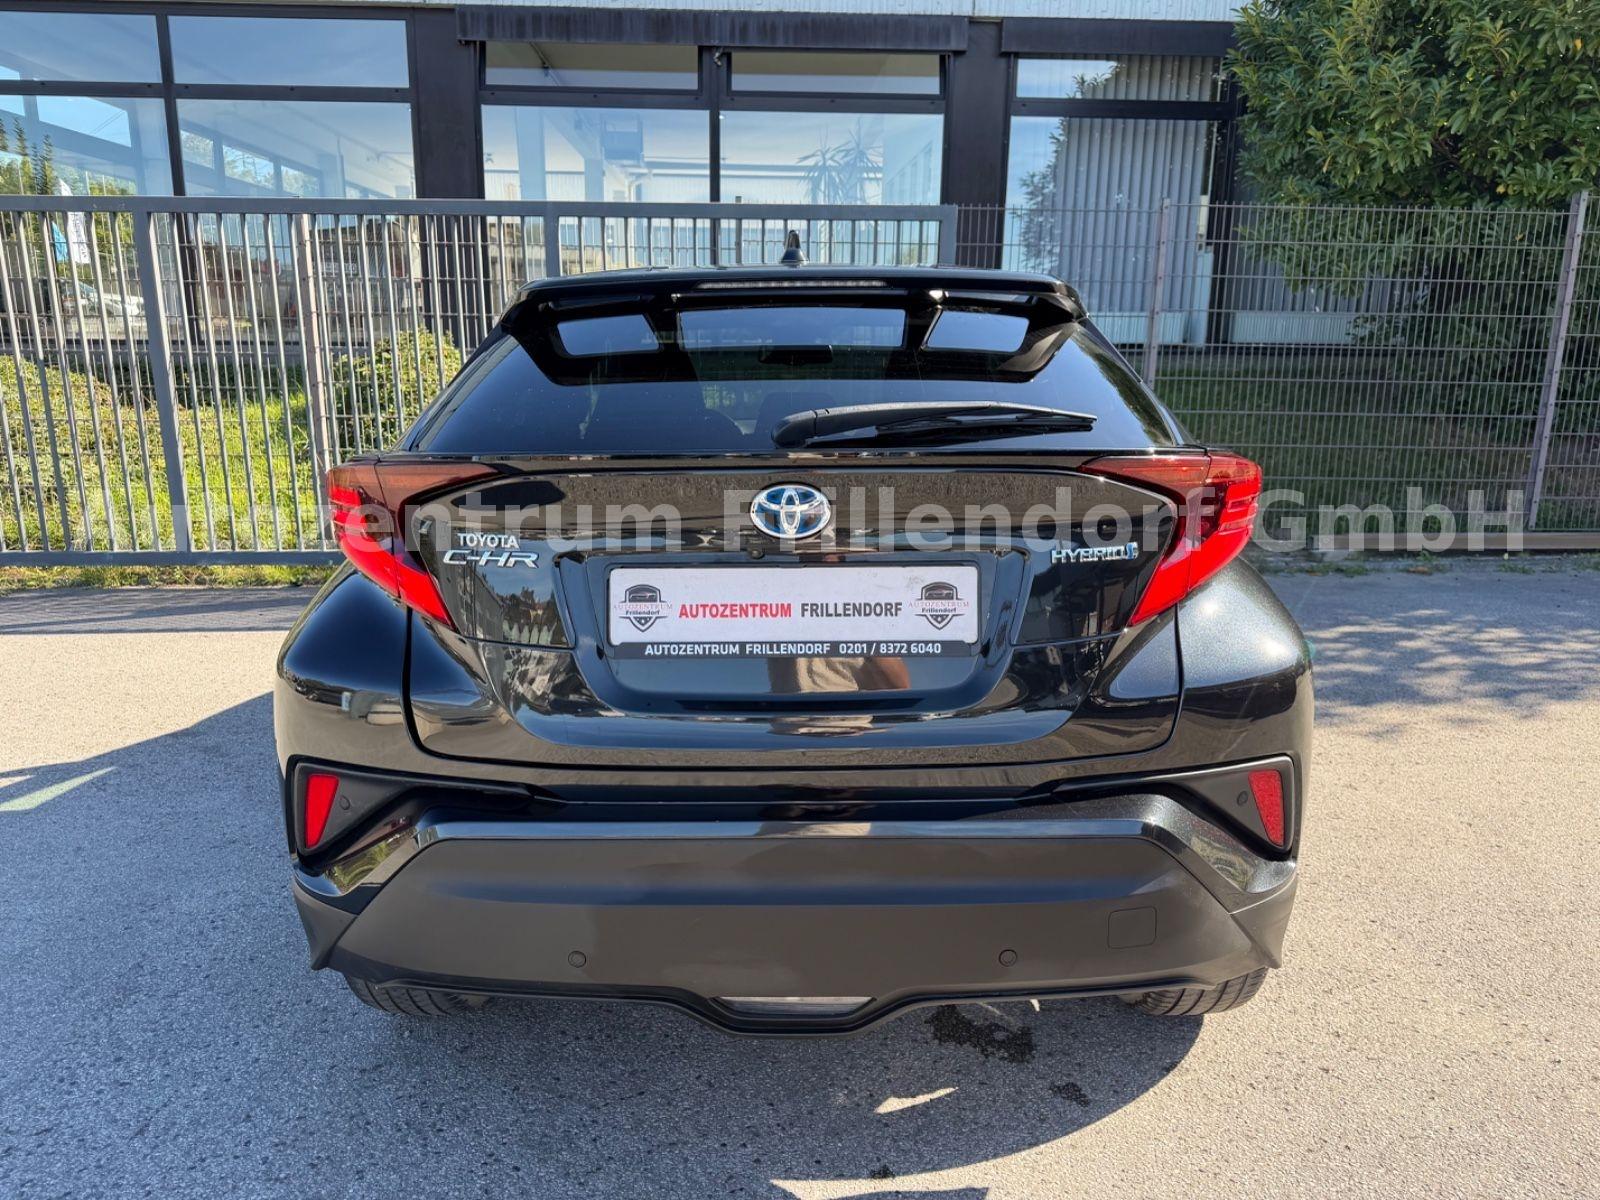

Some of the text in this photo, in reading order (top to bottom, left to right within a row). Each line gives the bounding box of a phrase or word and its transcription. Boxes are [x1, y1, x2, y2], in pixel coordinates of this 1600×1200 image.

[457, 532, 520, 549] TOYOTA
[443, 549, 540, 569] C-HR
[1051, 545, 1125, 564] HYBRID
[678, 602, 903, 619] AUTOZENTRUM FRILLENDORF
[644, 642, 942, 656] AUTOZENTRUM FRILLENDORF 0201 / 8372 6040
